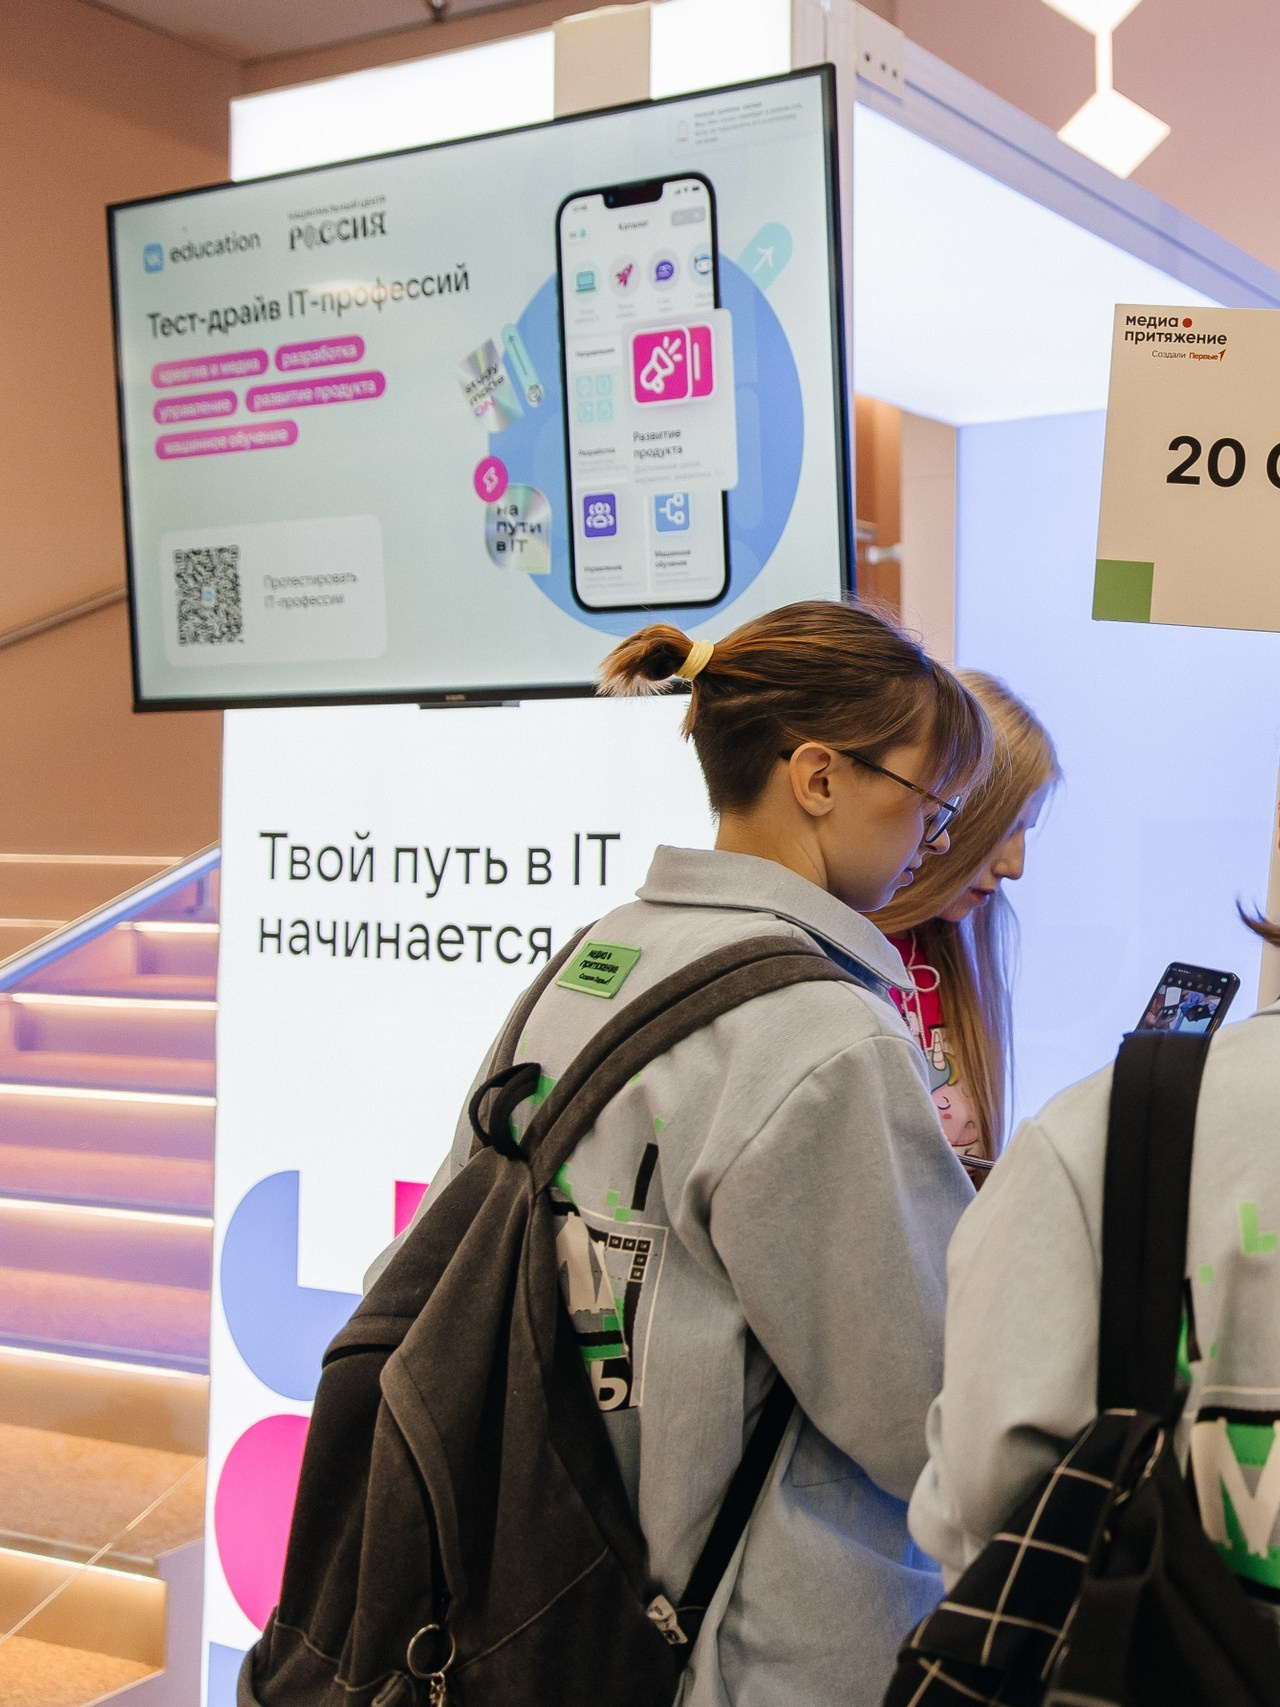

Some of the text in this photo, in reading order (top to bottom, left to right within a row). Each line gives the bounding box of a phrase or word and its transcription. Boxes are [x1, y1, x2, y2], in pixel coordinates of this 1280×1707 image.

[169, 231, 261, 263] education
[147, 262, 470, 338] Тест-драйв IT-профессий
[1125, 315, 1179, 329] медиа
[1124, 330, 1228, 345] притяжение
[281, 343, 358, 368] разработка
[1151, 349, 1187, 359] Создали
[314, 379, 377, 404] продукта
[157, 397, 232, 423] управление
[633, 429, 682, 442] Развитие
[633, 445, 683, 460] продукта
[1164, 435, 1247, 488] 20
[496, 504, 518, 517] на
[496, 520, 543, 537] пути
[496, 539, 506, 552] в
[263, 572, 358, 590] Протестировать
[259, 830, 621, 899] Твой путь в IT
[258, 916, 553, 965] начинается
